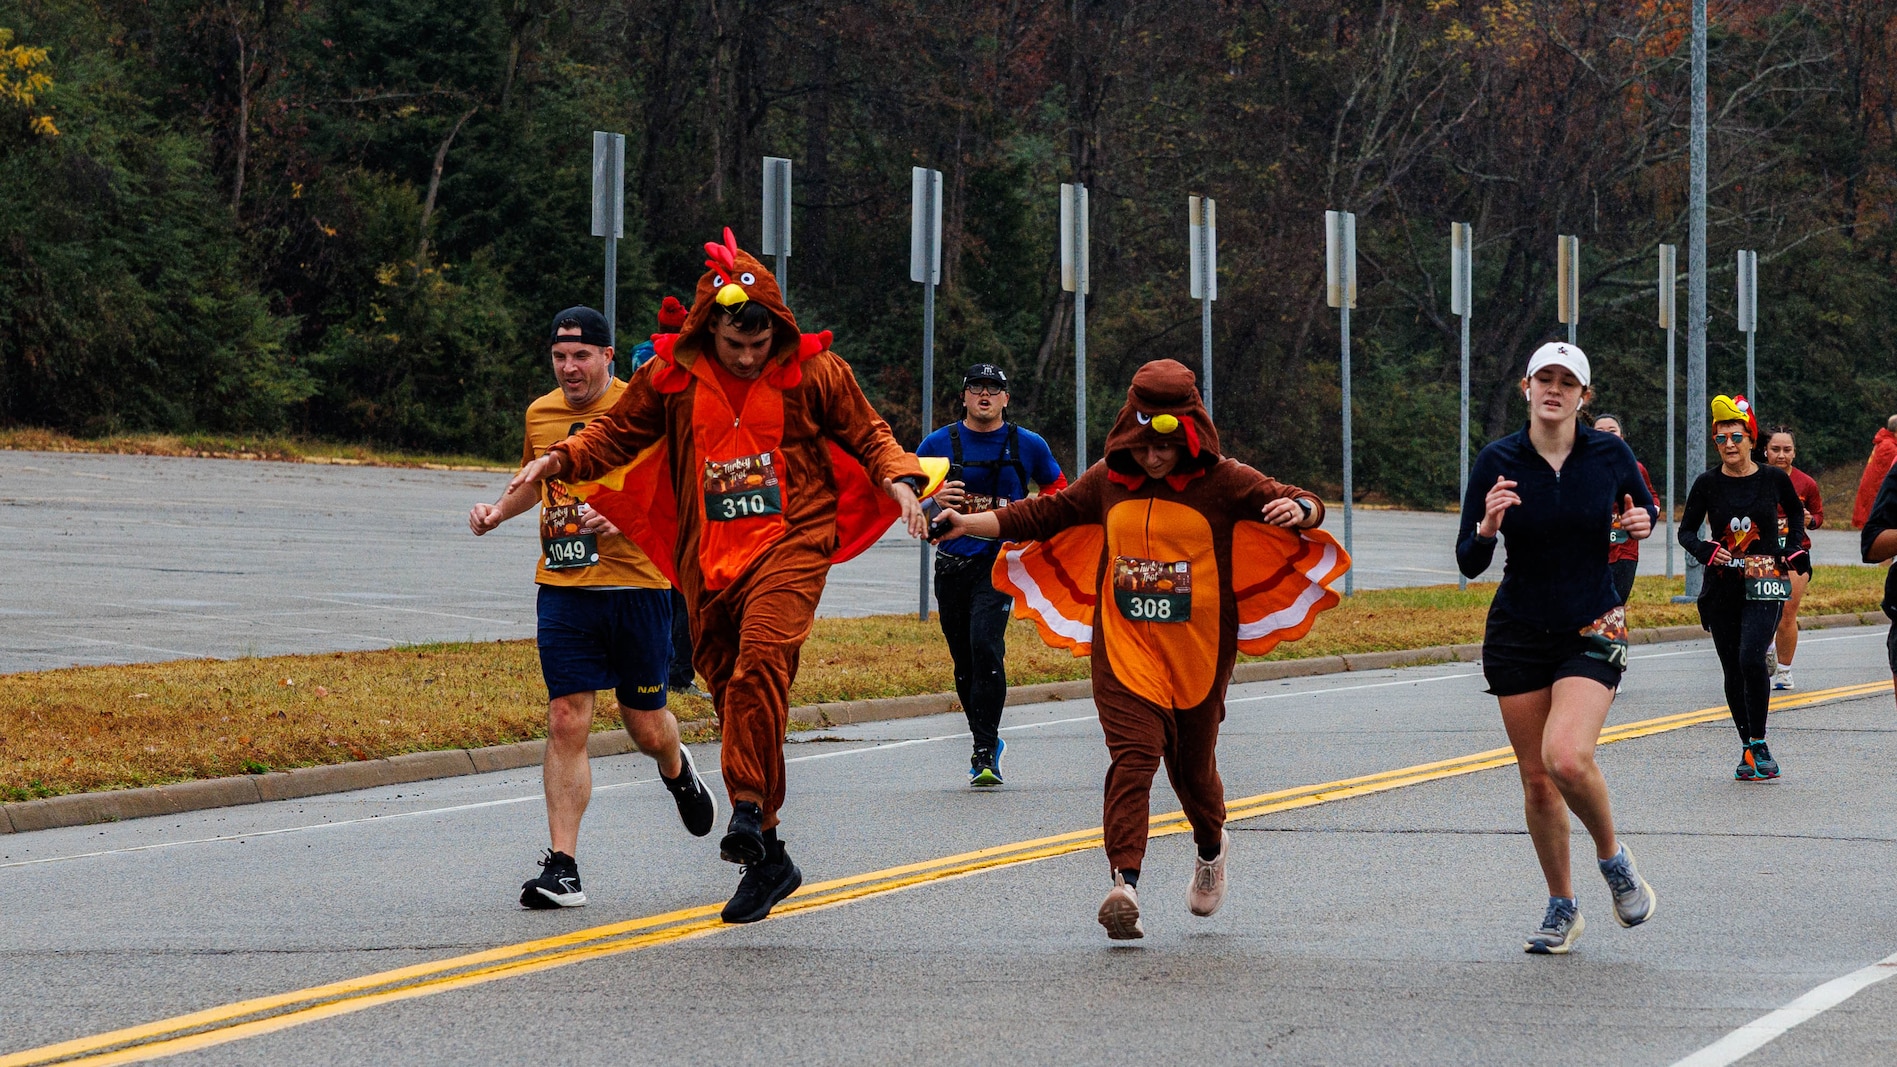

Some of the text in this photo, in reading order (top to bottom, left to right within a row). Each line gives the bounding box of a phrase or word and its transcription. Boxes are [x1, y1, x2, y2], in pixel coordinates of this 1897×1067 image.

[723, 457, 751, 474] Turkey
[730, 470, 747, 481] Trot
[549, 507, 569, 520] Turkey
[722, 494, 765, 519] 310
[549, 541, 586, 562] 1049
[1143, 572, 1159, 582] Trot
[1754, 581, 1786, 596] 1084
[1130, 597, 1172, 619] 308
[1608, 643, 1627, 667] 78
